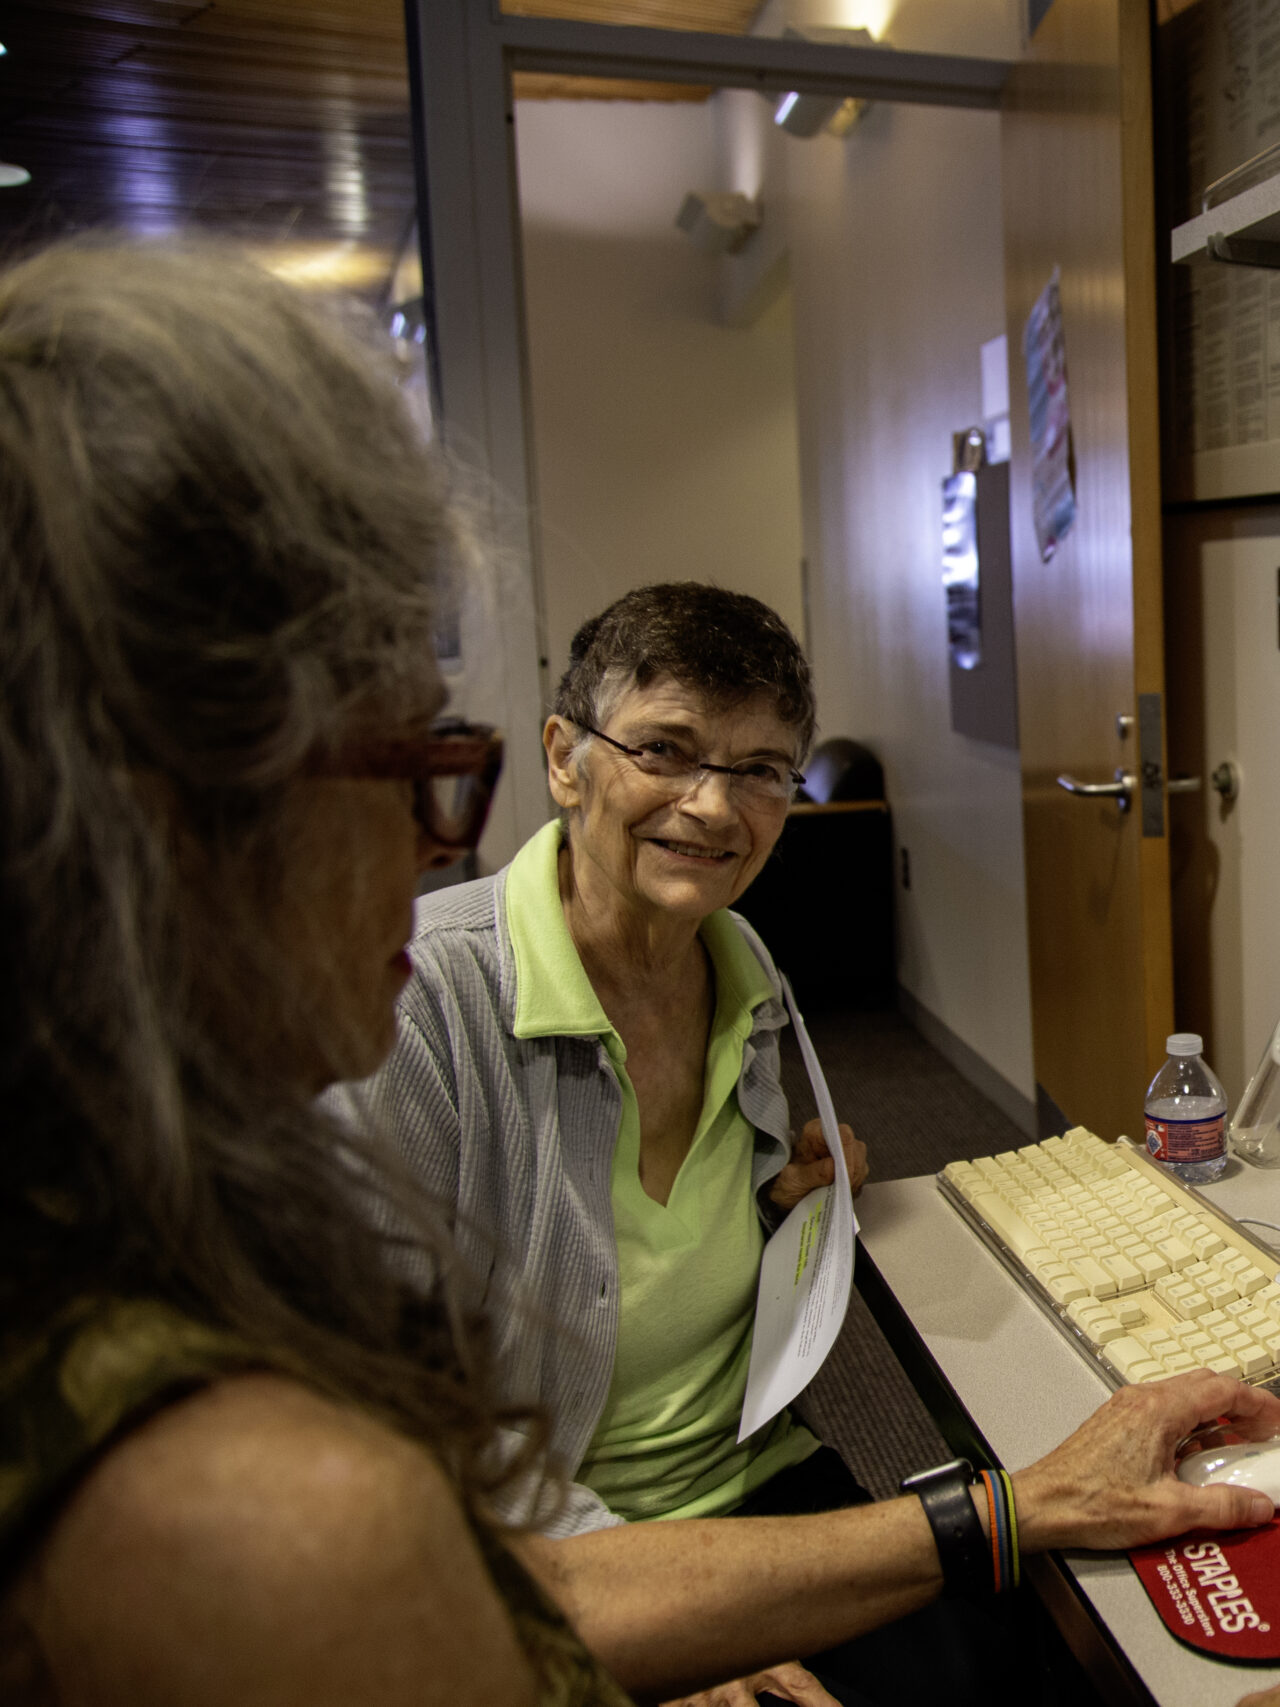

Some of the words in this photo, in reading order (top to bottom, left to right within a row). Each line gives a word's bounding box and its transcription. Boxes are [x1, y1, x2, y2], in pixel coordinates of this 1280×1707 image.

[1156, 1564, 1195, 1626] 800-333-3330
[1165, 1549, 1176, 1564] The
[1173, 1564, 1191, 1589] Office
[1186, 1588, 1215, 1637] Superstore
